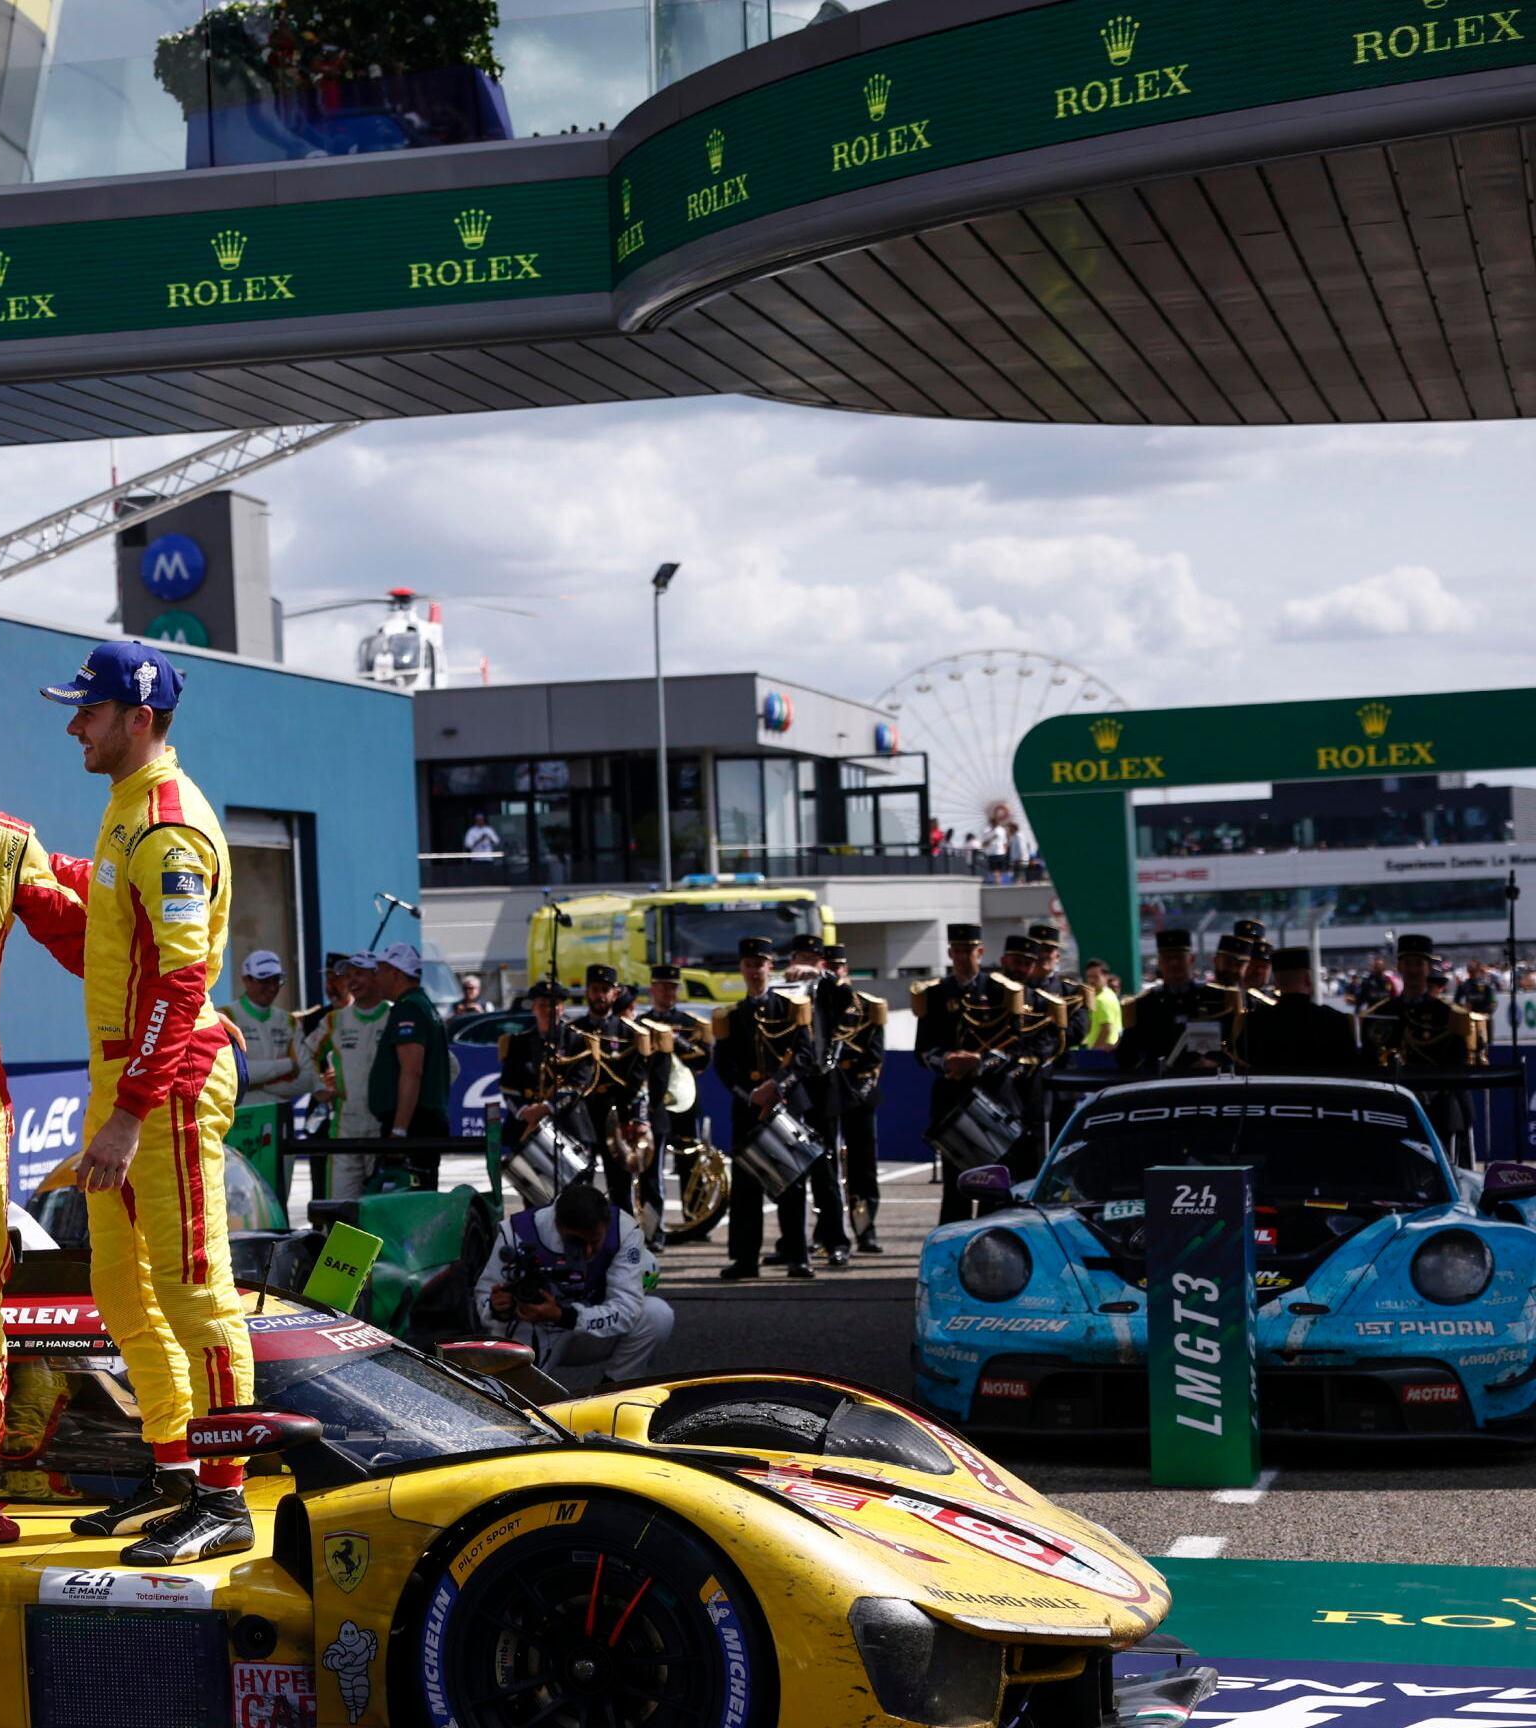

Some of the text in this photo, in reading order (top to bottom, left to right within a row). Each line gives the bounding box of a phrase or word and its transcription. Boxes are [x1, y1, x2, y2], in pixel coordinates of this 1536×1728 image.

[1353, 9, 1525, 65] ROLEX
[1054, 64, 1192, 119] ROLEX
[832, 119, 932, 172] ROLEX
[688, 185, 749, 222] ROLEX
[409, 253, 541, 288] ROLEX
[167, 274, 295, 308] ROLEX
[1317, 742, 1436, 770] ROLEX
[1052, 756, 1165, 784] ROLEX
[1136, 867, 1209, 883] SCHE
[141, 998, 170, 1057] ORLEN
[18, 1097, 81, 1154] WEC
[1083, 1105, 1409, 1129] PORSCHE
[1171, 1184, 1217, 1208] 24h
[1170, 1207, 1217, 1215] LE MANS
[323, 1254, 359, 1279] SAFE
[0, 1307, 79, 1325] RLEN
[944, 1315, 1071, 1333] 1ST PHORM
[1354, 1320, 1495, 1337] 1ST PHORM
[46, 1340, 91, 1349] HANSON
[1171, 1272, 1224, 1437] LMGT3
[980, 1380, 1027, 1396] MOTUL
[1405, 1387, 1459, 1402] MOTUL
[191, 1428, 243, 1446] ORLEN
[457, 1517, 522, 1573] PILOT SPORT
[65, 1570, 116, 1588] 24h
[78, 1587, 111, 1596] MANS
[136, 1592, 189, 1603] TotalEnergies
[922, 1585, 1089, 1610] RICHARD MILLE
[423, 1587, 453, 1717] MICHELIN
